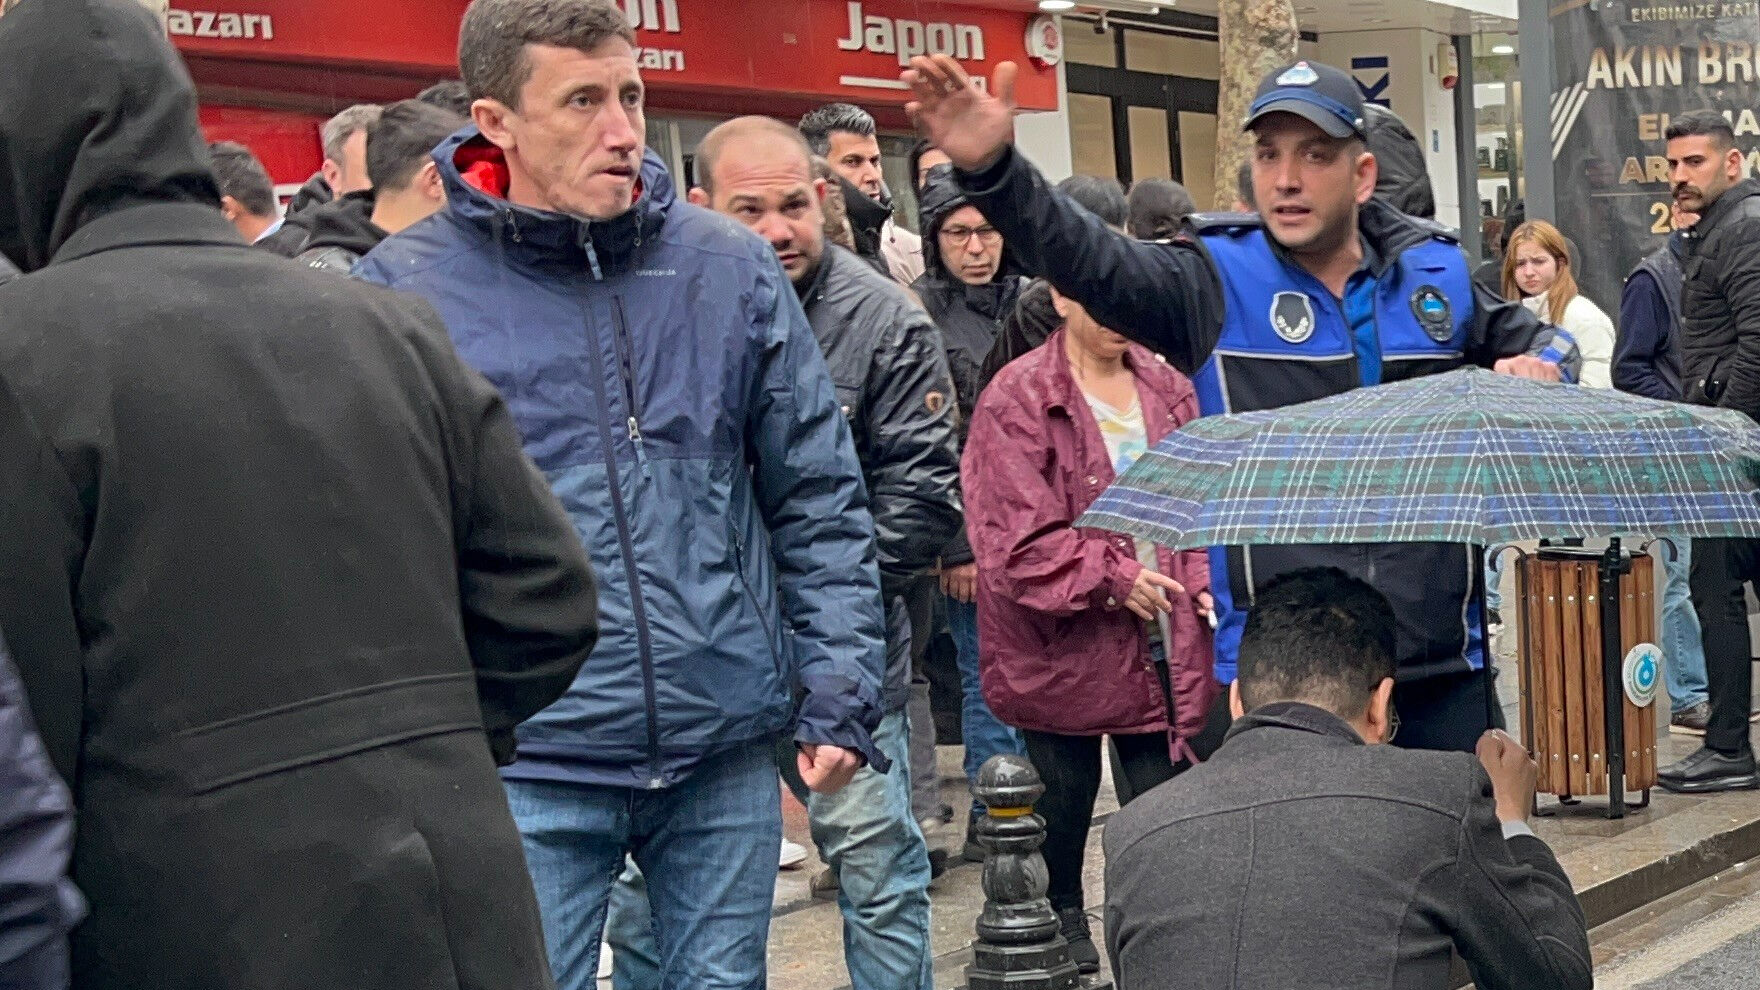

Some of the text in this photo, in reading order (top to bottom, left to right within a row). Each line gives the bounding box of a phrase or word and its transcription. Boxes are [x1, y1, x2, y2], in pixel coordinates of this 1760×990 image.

[167, 9, 274, 40] azarı
[837, 1, 985, 68] Japon
[1586, 46, 1683, 90] AKIN
